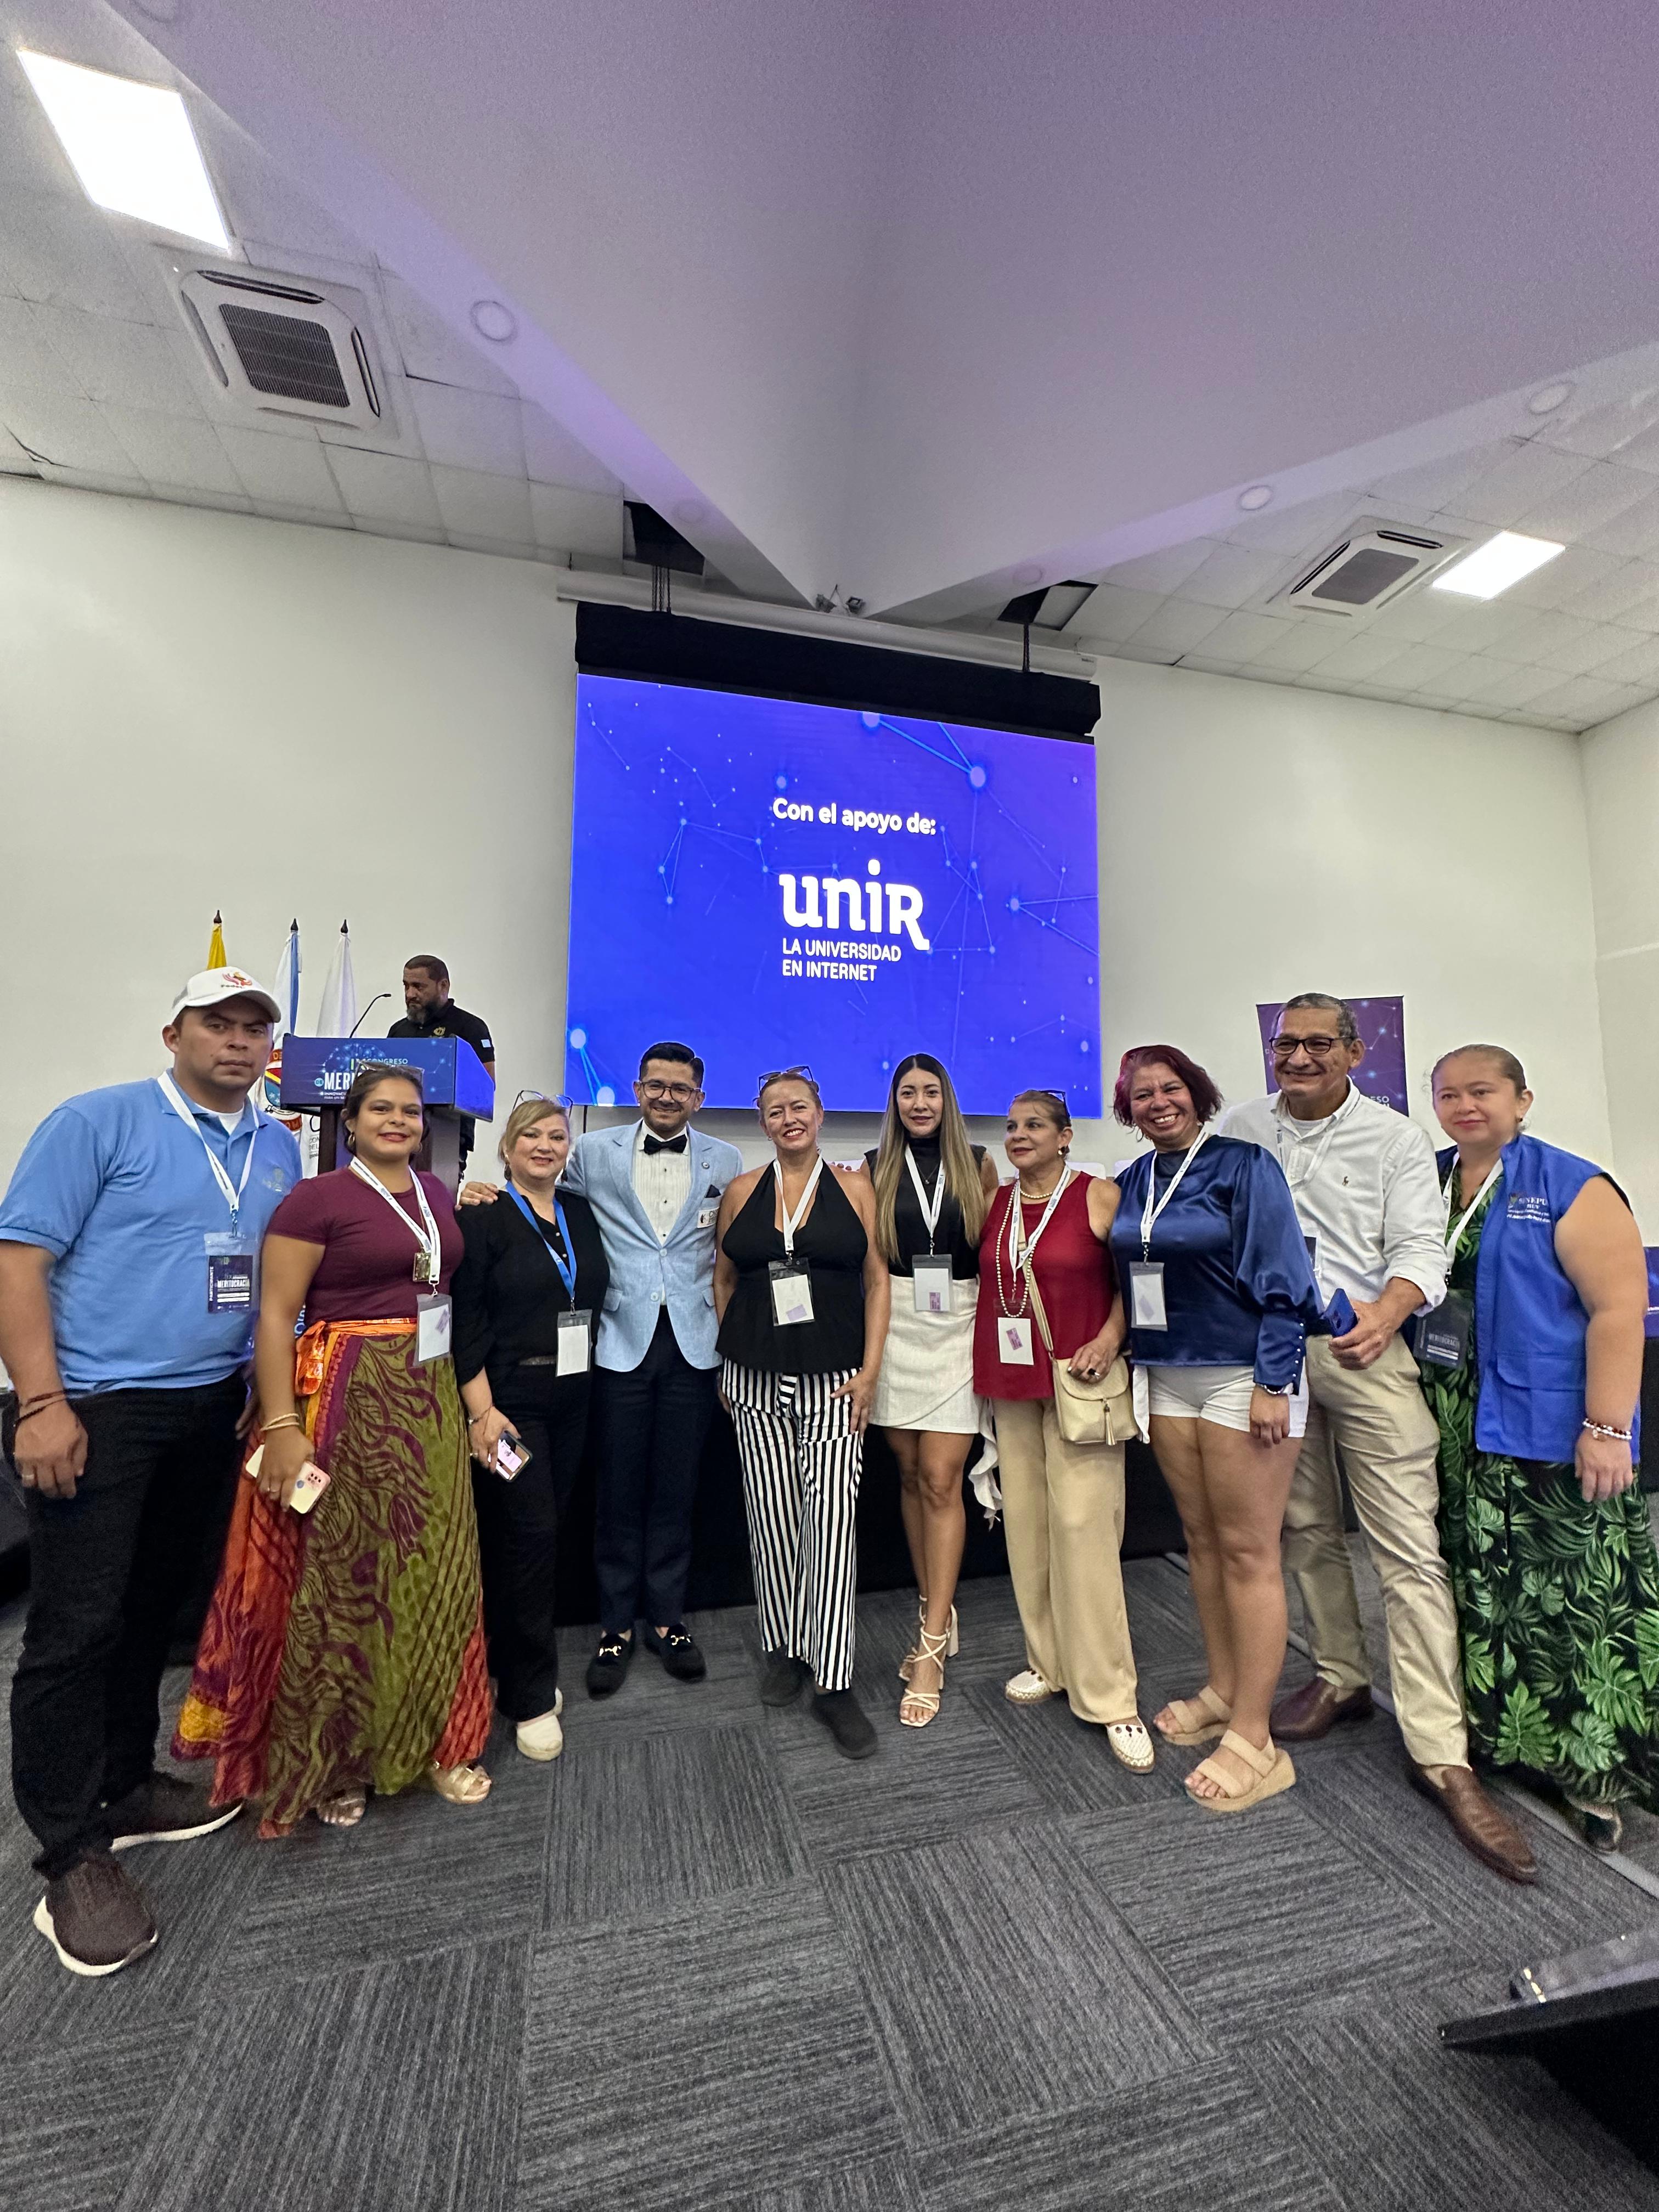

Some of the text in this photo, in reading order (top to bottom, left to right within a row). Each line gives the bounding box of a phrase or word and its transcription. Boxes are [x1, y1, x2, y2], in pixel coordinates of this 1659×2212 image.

[772, 797, 936, 835] Con el apoyo de:
[782, 938, 902, 962] LA UNIVERSIDAD
[782, 959, 877, 981] EN INTERNET
